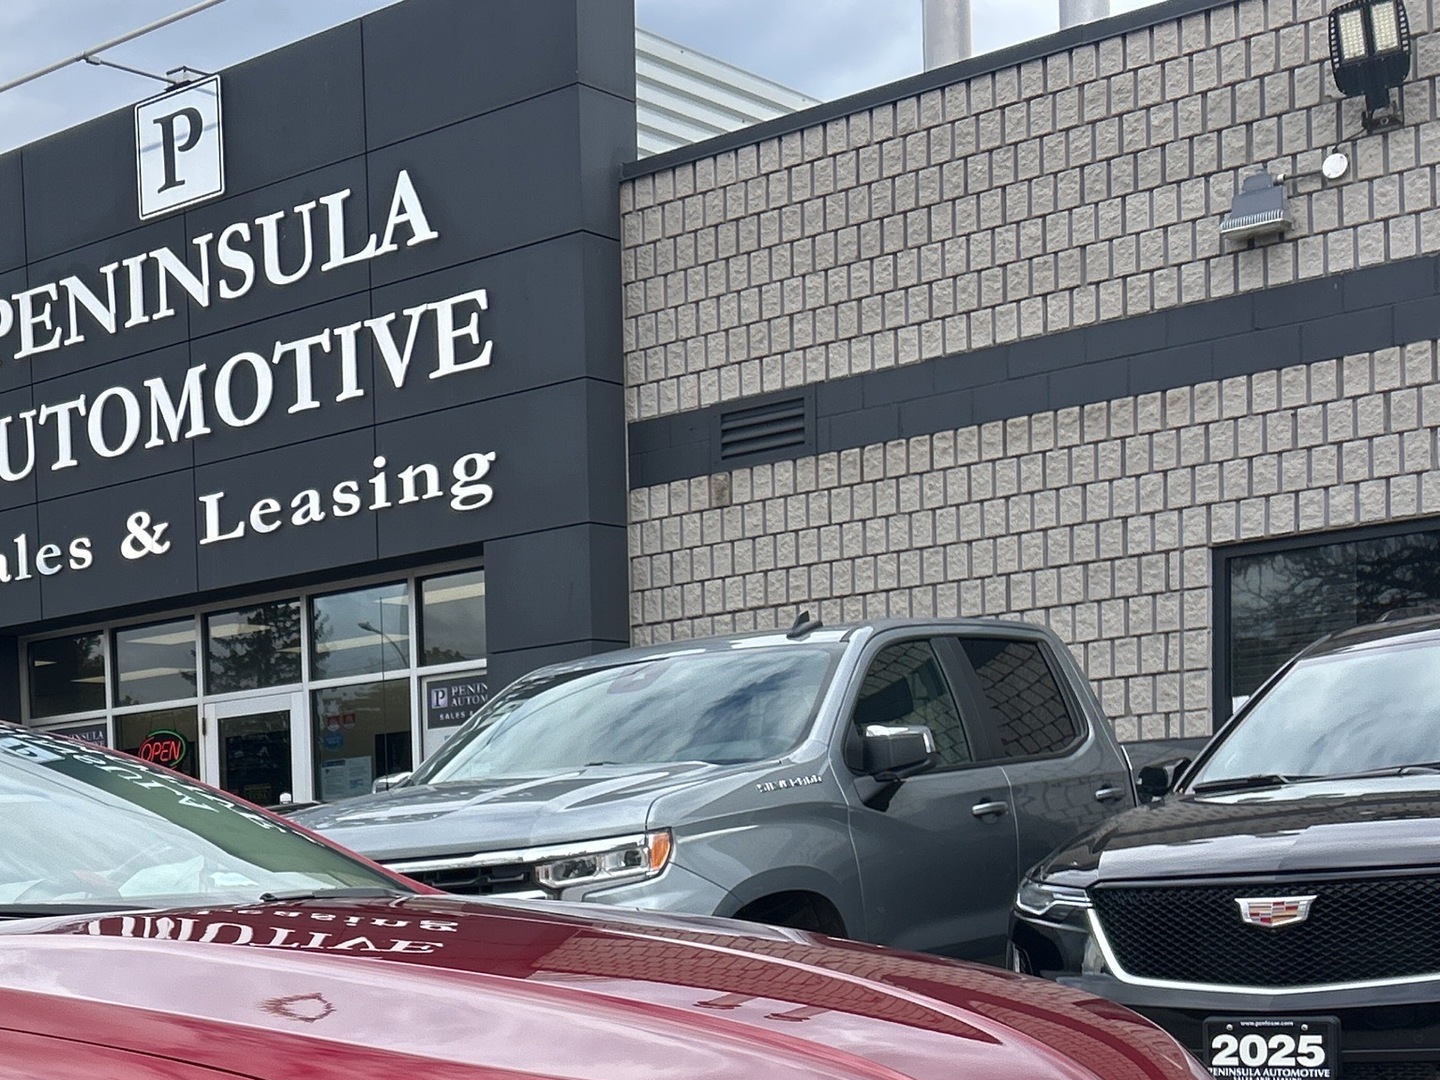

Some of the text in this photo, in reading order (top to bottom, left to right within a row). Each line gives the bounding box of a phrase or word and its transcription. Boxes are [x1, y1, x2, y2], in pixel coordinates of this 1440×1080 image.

[153, 105, 203, 194] P
[120, 511, 171, 560] &
[199, 451, 497, 546] Leasing
[440, 711, 466, 720] SALES
[141, 740, 182, 762] OPEN
[1211, 1033, 1326, 1067] 2025
[1263, 1068, 1330, 1078] AUTOMOTIVE
